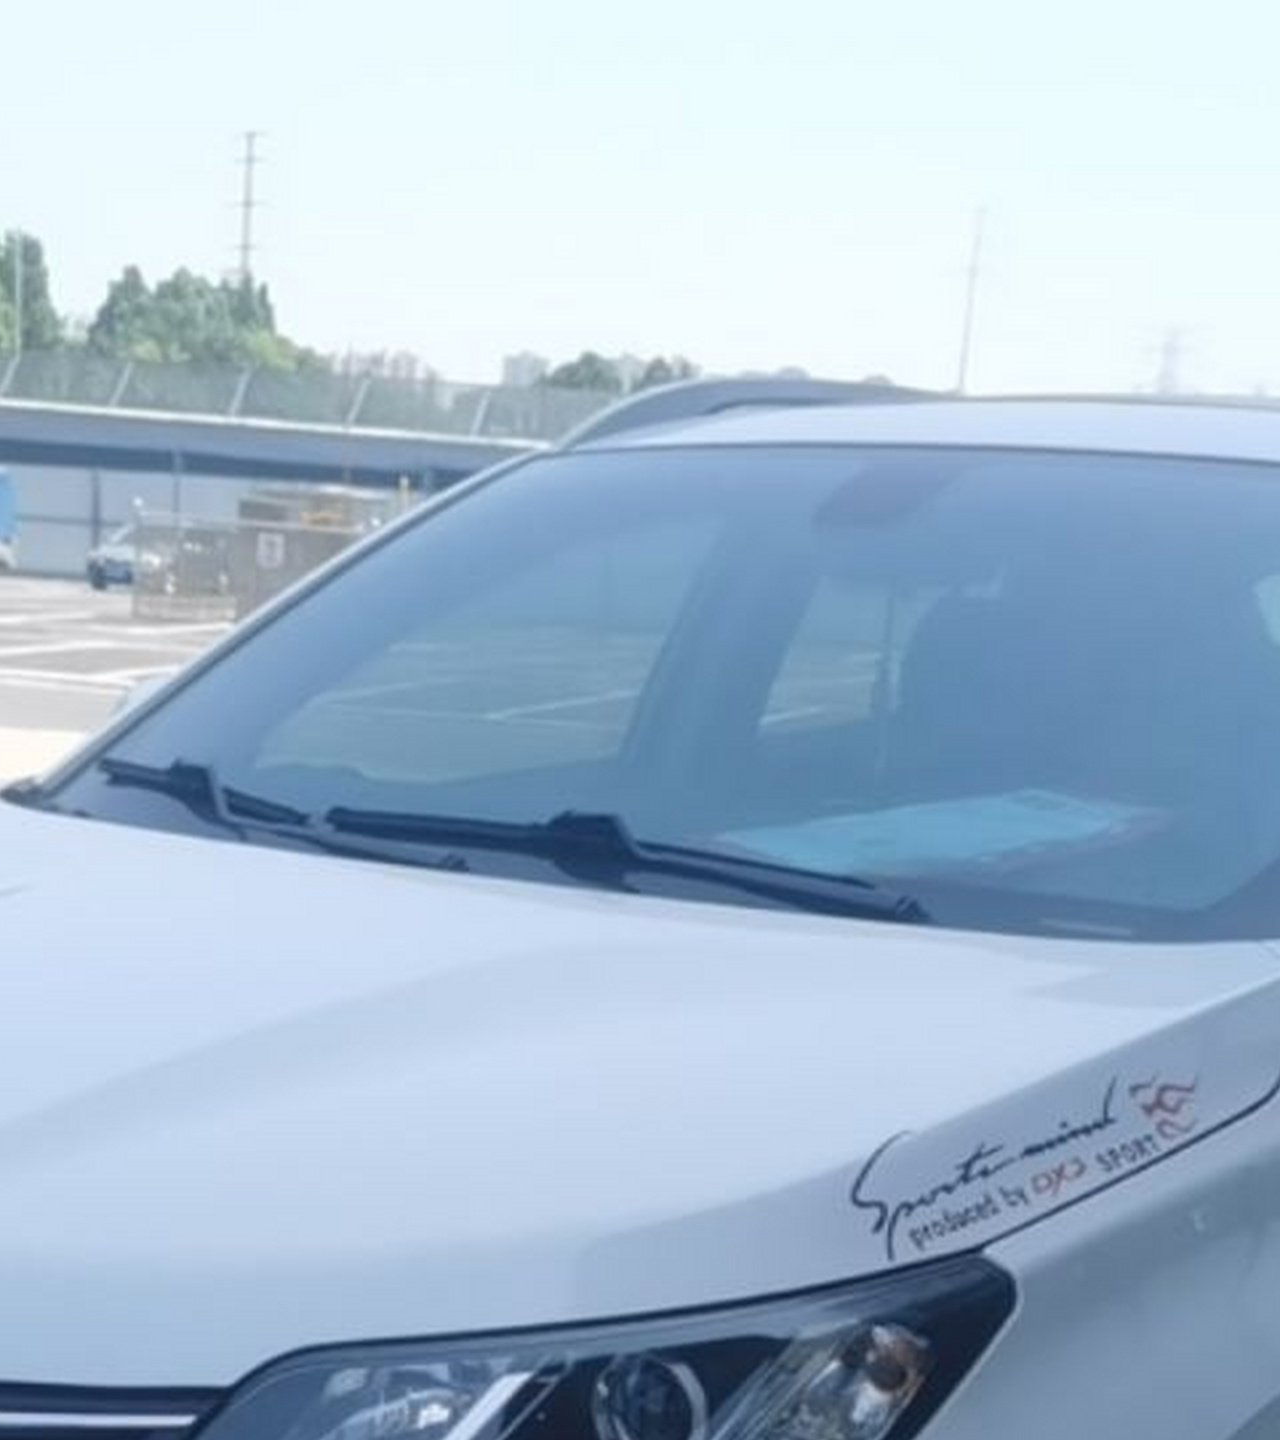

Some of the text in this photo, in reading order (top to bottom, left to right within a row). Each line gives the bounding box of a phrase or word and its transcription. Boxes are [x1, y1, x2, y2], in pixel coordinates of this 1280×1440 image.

[909, 1194, 1001, 1250] produced
[999, 1182, 1030, 1206] by
[1096, 1134, 1160, 1173] SPORT
